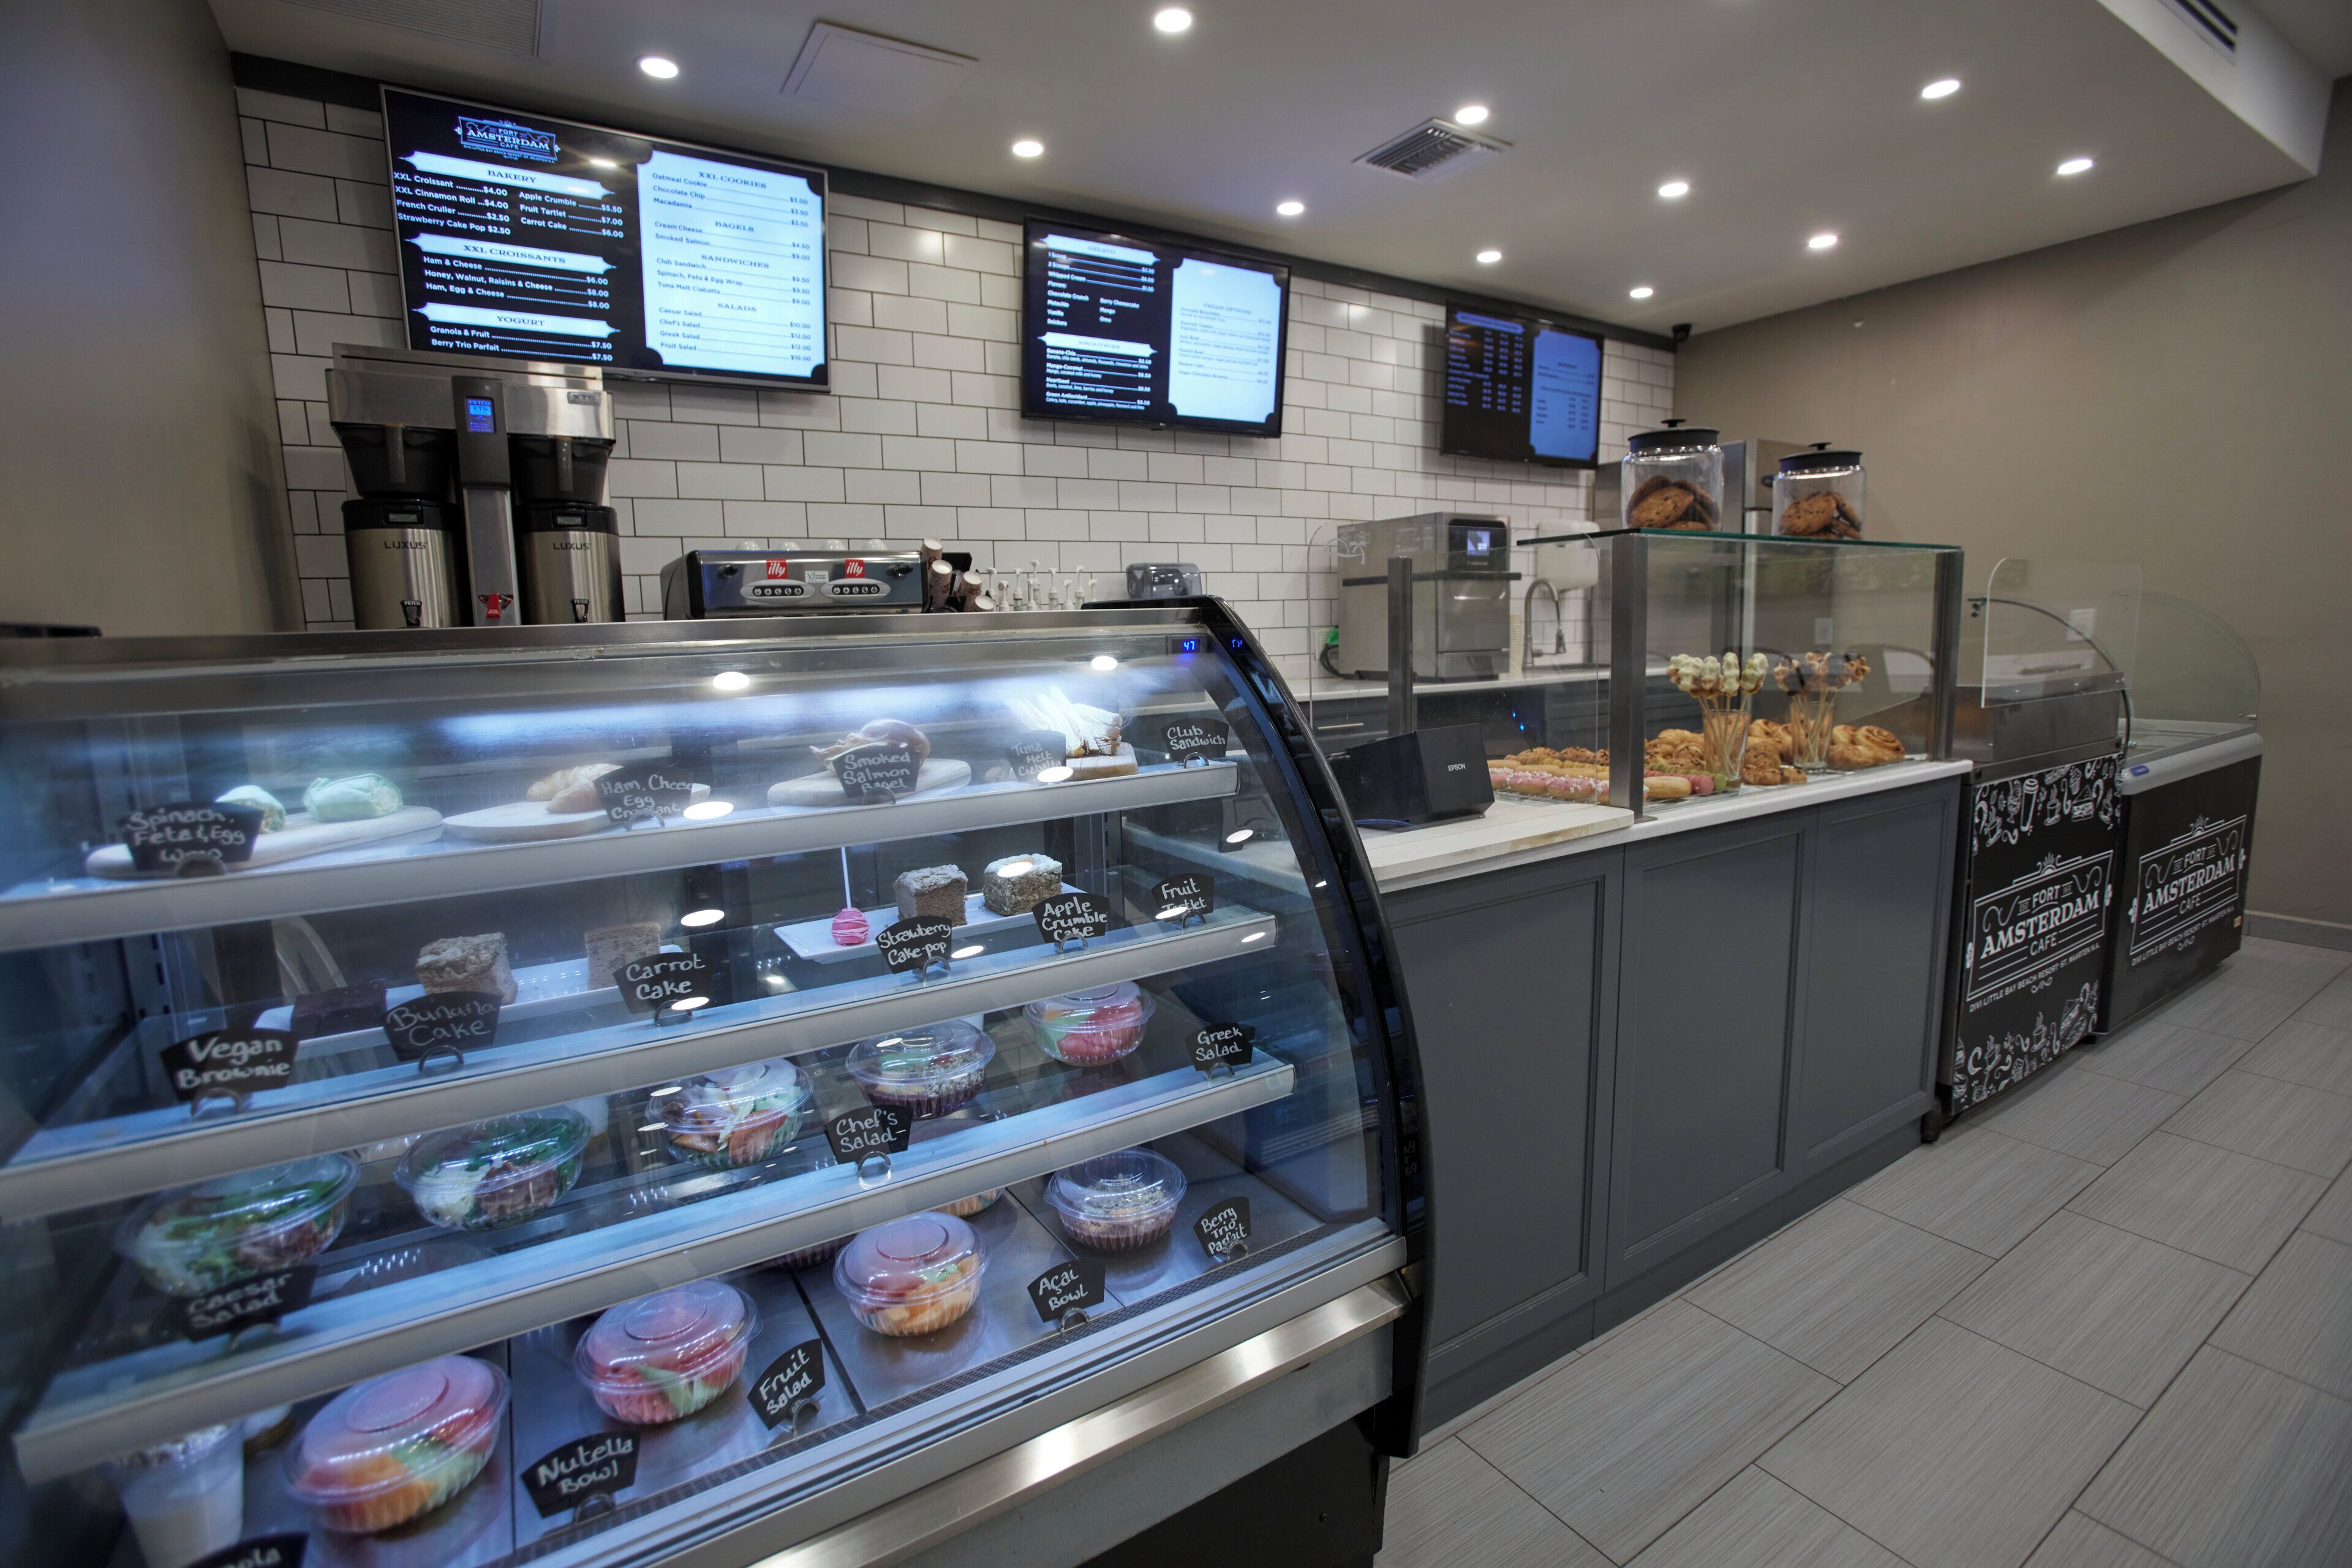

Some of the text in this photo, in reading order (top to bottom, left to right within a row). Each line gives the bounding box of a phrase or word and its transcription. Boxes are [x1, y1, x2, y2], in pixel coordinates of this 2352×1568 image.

[467, 129, 550, 150] AMSTERDAM
[499, 128, 518, 137] FORT
[394, 172, 508, 196] XXL Croissant $4.00
[488, 170, 537, 183] BAKERY
[652, 173, 707, 187] Oatmeal Cookie
[699, 172, 767, 189] XXL COOKIES
[395, 186, 508, 209] XXL Cinnamon Roll $4.00
[519, 191, 622, 214] Apple Crumble $5.50
[653, 185, 705, 200] Chocolate Chip
[397, 200, 510, 222] French Cruller $2.50
[654, 198, 692, 209] Macadamia
[398, 213, 511, 235] Strawberry Cake Pop $2.50
[520, 204, 623, 226] Fruit Tartlet $7.00
[521, 217, 624, 238] Carrot Cake $6.00
[679, 225, 703, 233] Cheese
[715, 221, 754, 232] BAGELS
[655, 233, 683, 243] Smoked
[464, 245, 565, 263] XXL CROISSANTS
[1088, 246, 1116, 254] GELATO
[423, 256, 443, 265] Ham
[453, 260, 483, 270] Cheese
[586, 276, 608, 285] $6.00
[674, 260, 706, 270] Sandwich
[701, 254, 769, 268] SANDWICHES
[424, 270, 451, 280] Honey,
[455, 274, 486, 284] Walnut,
[489, 277, 516, 287] Raisins
[526, 281, 552, 291] Cheese
[587, 288, 609, 298] $8.00
[657, 270, 686, 279] Spinach,
[426, 282, 447, 292] Ham,
[450, 285, 466, 295] Egg
[475, 288, 505, 298] Cheese
[588, 301, 609, 309] $8.00
[717, 303, 757, 312] SALADS
[497, 315, 545, 326] YOGURT
[430, 326, 462, 336] Granola
[471, 330, 490, 338] Fruit
[591, 341, 612, 350] $7.50
[1079, 341, 1120, 349] SMOOTHIES
[432, 339, 454, 349] Berry
[473, 343, 500, 352] Parfait
[592, 353, 612, 362] $7.50
[385, 541, 426, 549] LUXUS
[768, 562, 785, 577] illy
[847, 562, 863, 577] illy
[1183, 641, 1195, 650] 47
[1167, 725, 1203, 739] Club
[1170, 734, 1226, 750] Sandwich
[1011, 742, 1043, 756] Tuna
[1027, 750, 1052, 763] Melt
[845, 752, 911, 769] Smoked
[843, 768, 910, 785] Salmon
[601, 780, 646, 795] Ham,
[624, 795, 655, 808] Egg
[135, 825, 193, 846] Feta
[211, 825, 246, 845] Egg
[2184, 847, 2206, 868] FORT
[1161, 878, 1200, 899] Fruit
[2142, 854, 2235, 915] AMSTERDAM
[1043, 896, 1093, 917] Apple
[2032, 885, 2060, 908] FORT
[2179, 892, 2201, 914] CAFE
[1042, 912, 1107, 930] Crumble
[1980, 891, 2100, 959] AMSTERDAM
[878, 924, 951, 948] Strawberry
[1054, 926, 1095, 941] Cake
[2030, 932, 2057, 956] CAFE
[888, 942, 947, 965] Cake-pop
[626, 953, 706, 981] Carrot
[636, 980, 692, 1000] Cake
[1983, 965, 2058, 1006] LITTLE BAY BEACH RESORT
[409, 1020, 491, 1046] Cake
[1197, 1027, 1243, 1045] Greek
[188, 1036, 283, 1065] Vegan
[1196, 1041, 1242, 1061] Salad
[178, 1059, 291, 1089] Brownie
[837, 1109, 898, 1136] Chef's
[840, 1127, 897, 1152] Salad
[1201, 1207, 1237, 1233] Berry
[1211, 1221, 1235, 1238] Trio
[1049, 1284, 1088, 1311] Bowl
[760, 1349, 810, 1401] Fruit
[767, 1371, 813, 1414] Salad
[538, 1438, 634, 1487] Nutella
[557, 1459, 618, 1494] Bowl
